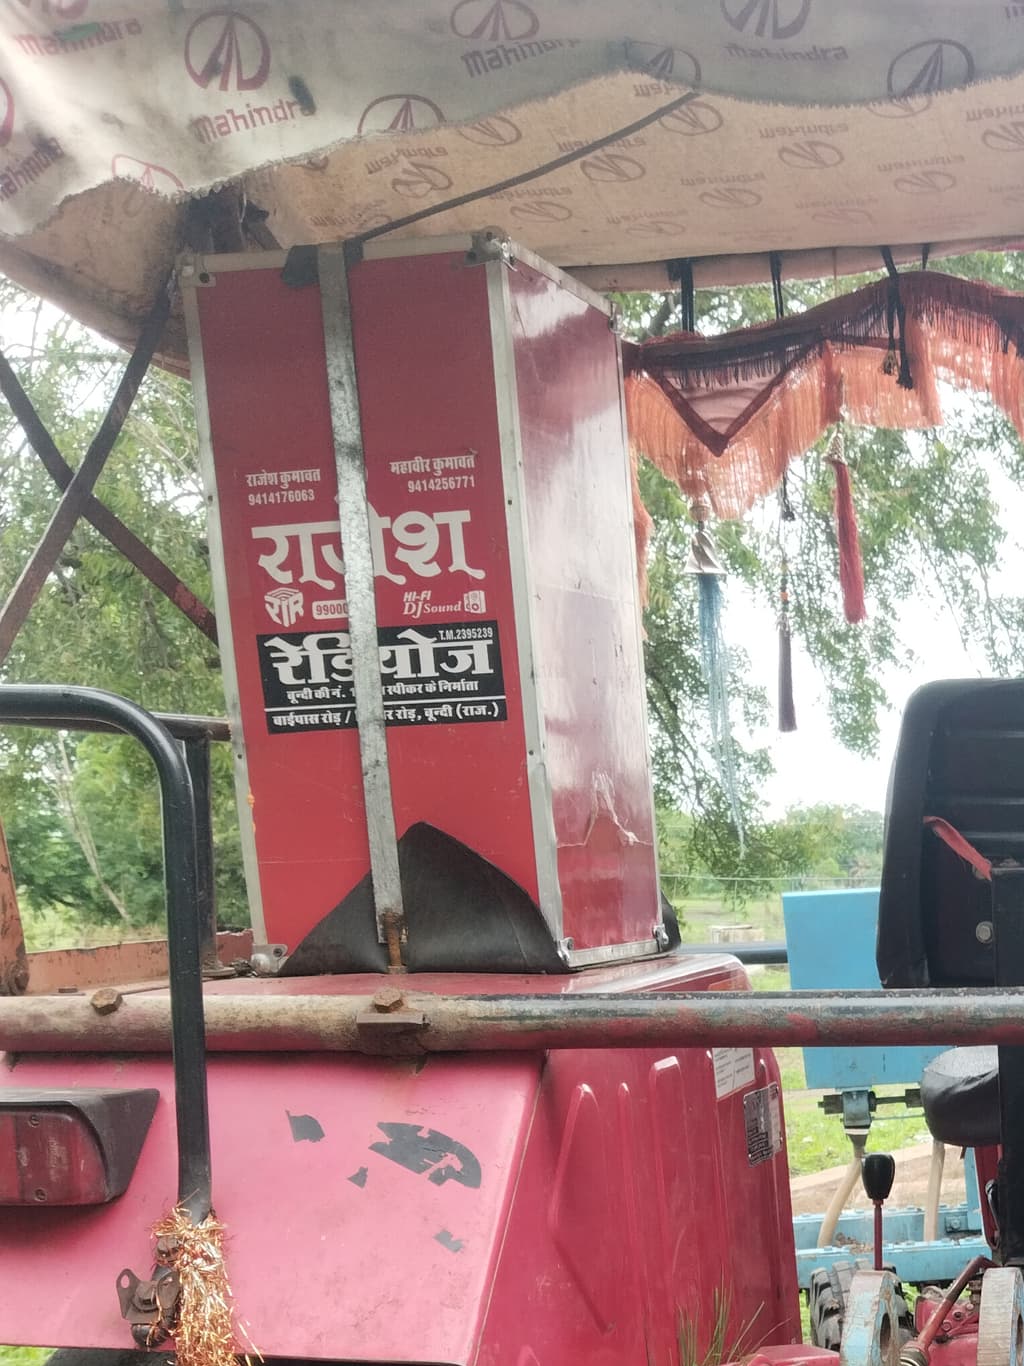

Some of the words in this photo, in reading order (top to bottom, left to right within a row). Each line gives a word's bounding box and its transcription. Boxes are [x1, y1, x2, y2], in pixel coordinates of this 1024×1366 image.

[389, 455, 430, 475] महावीर
[431, 454, 475, 477] कुमावत
[245, 468, 278, 487] राजेश
[279, 468, 320, 490] कुमावत
[407, 475, 475, 494] 9414256771
[248, 489, 315, 506] 9414176063
[403, 590, 432, 602] HI-FI
